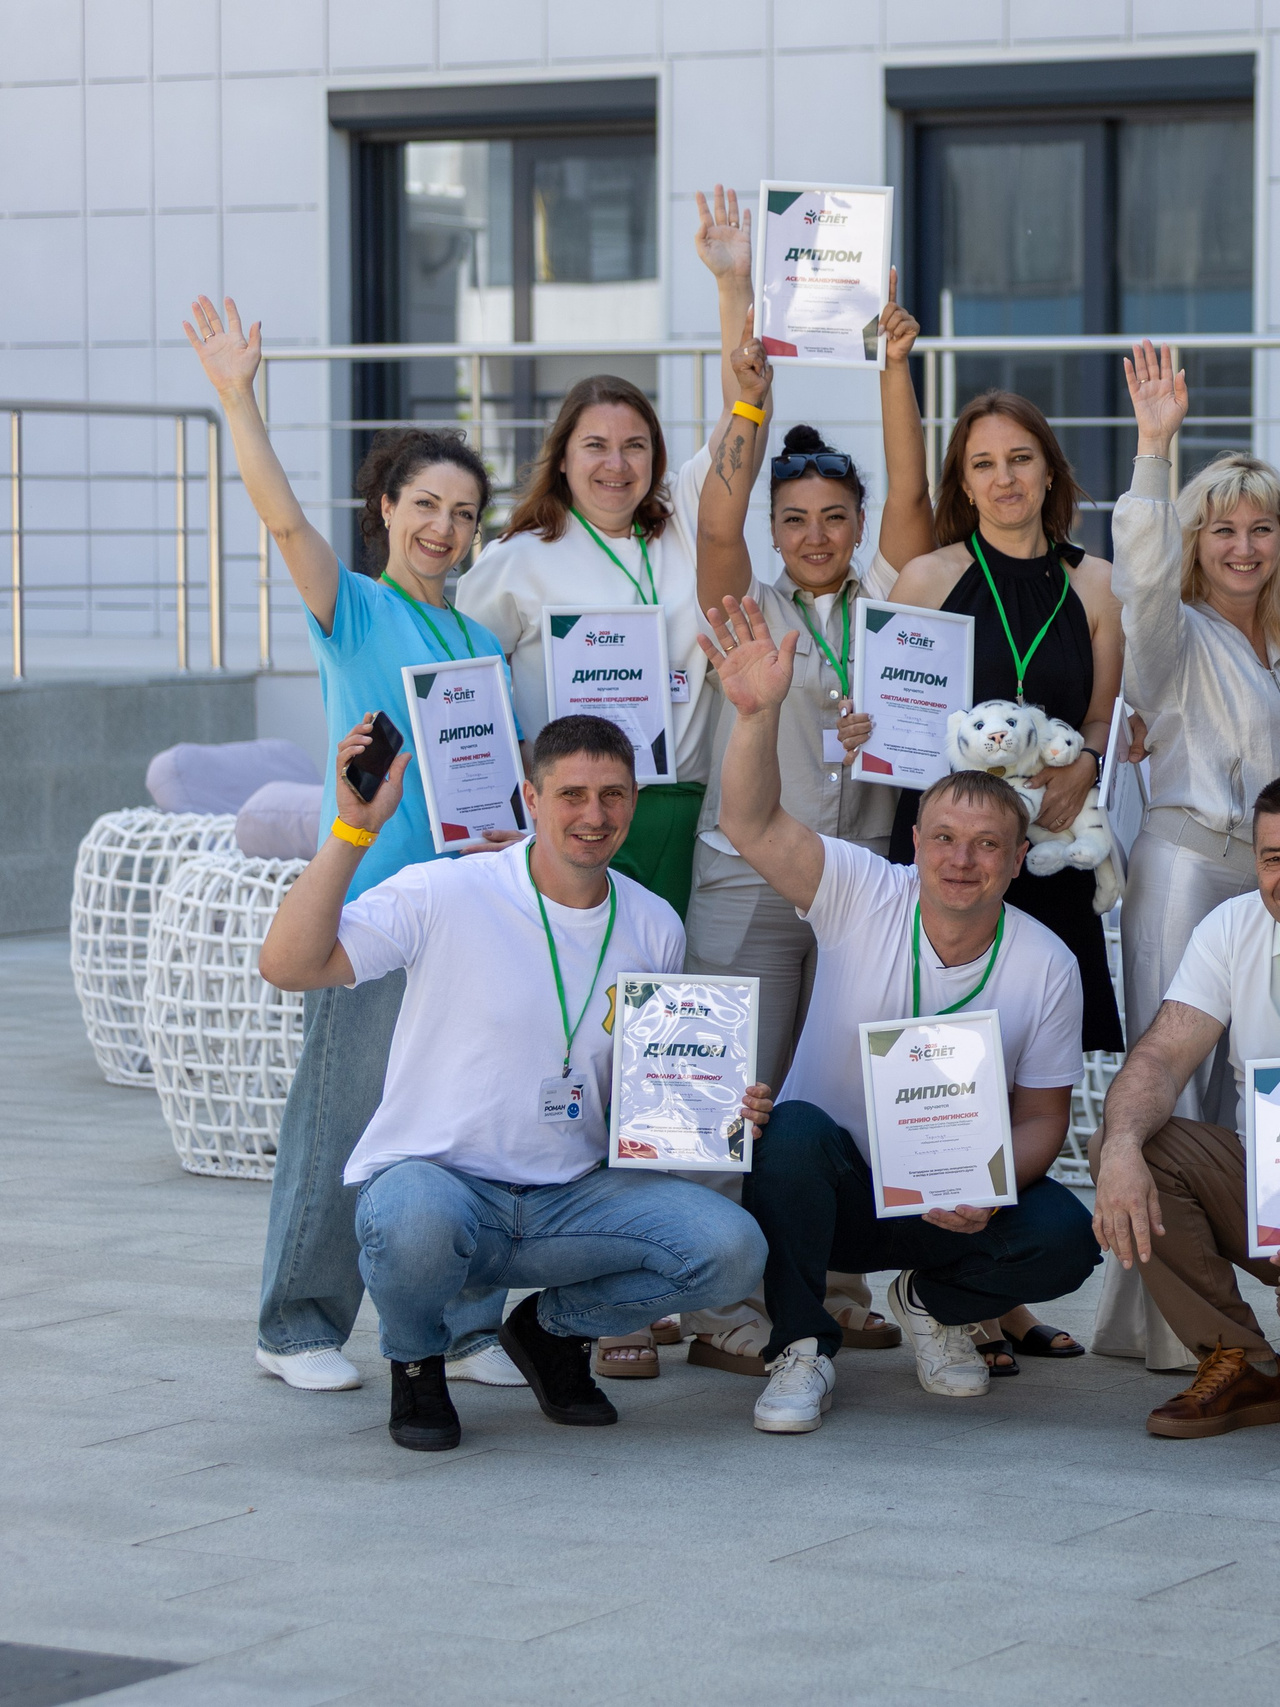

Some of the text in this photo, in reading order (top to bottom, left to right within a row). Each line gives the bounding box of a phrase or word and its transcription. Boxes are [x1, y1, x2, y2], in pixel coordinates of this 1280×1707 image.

[817, 213, 849, 225] СЛЁТ
[784, 247, 862, 263] ДИПЛОМ
[598, 633, 626, 644] СЛЁТ
[909, 637, 935, 648] СЛЁТ
[572, 669, 643, 683] ДИПЛОМ
[880, 666, 948, 688] ДИПЛОМ
[454, 689, 475, 701] СЛЁТ
[880, 694, 910, 703] СВЕТЛАНЕ
[439, 723, 494, 744] ДИПЛОМ
[643, 1043, 727, 1058] ДИПЛОМ
[924, 1045, 955, 1058] СЛЁТ
[895, 1081, 976, 1104] ДИПЛОМ
[898, 1116, 931, 1125] ЕВГЕНИЮ
